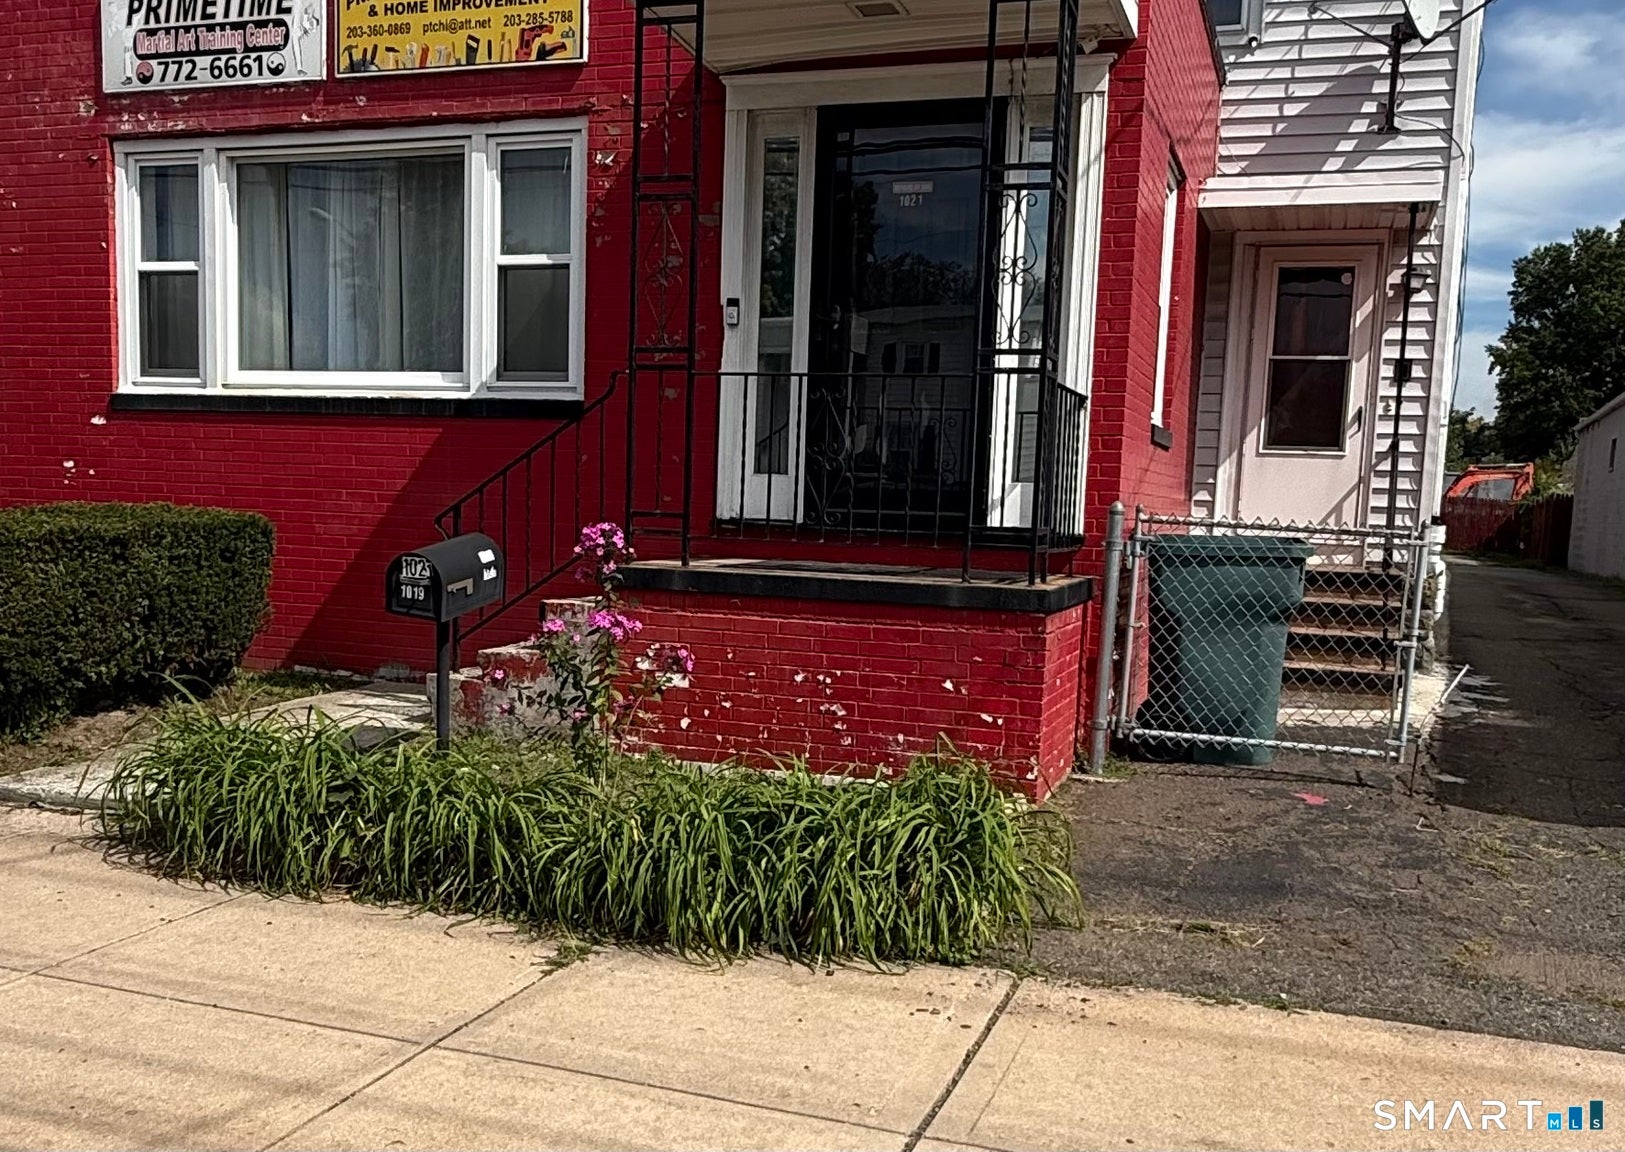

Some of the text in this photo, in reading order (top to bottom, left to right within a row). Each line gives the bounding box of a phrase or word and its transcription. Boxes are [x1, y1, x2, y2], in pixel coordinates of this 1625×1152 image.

[368, 5, 379, 17] &
[384, 0, 429, 16] HOME
[346, 22, 411, 39] 203-360-0869
[503, 10, 574, 27] 203-285-5788
[136, 23, 285, 55] Martial Art Training Center
[157, 54, 264, 83] 772-6661
[899, 194, 923, 207] 1021
[401, 585, 425, 600] 1019
